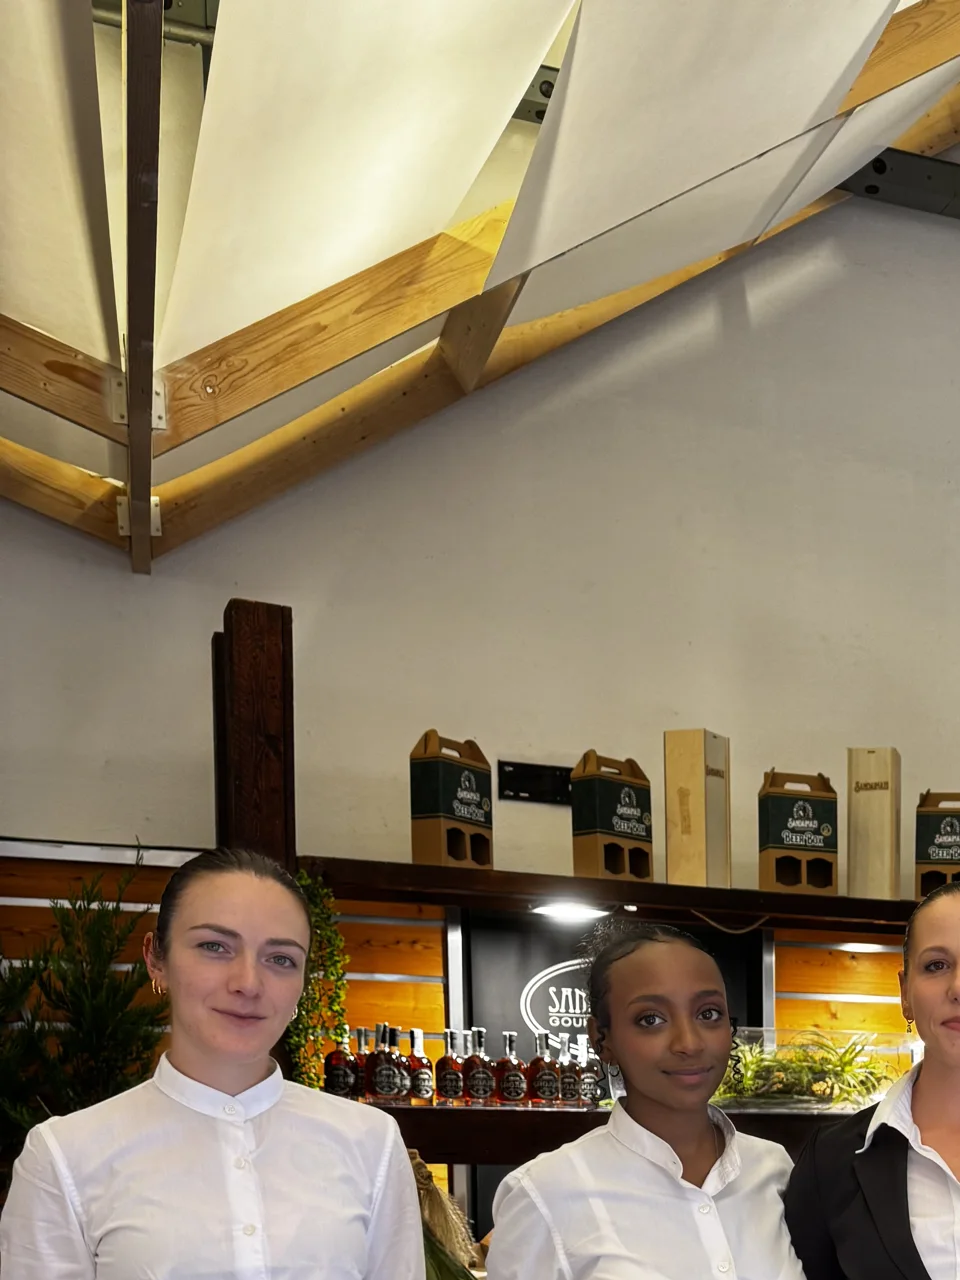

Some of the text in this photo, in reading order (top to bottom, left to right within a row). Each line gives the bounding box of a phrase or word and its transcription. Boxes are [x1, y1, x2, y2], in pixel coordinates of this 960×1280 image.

[782, 830, 824, 847] BEER BOX
[928, 846, 952, 859] BEER
